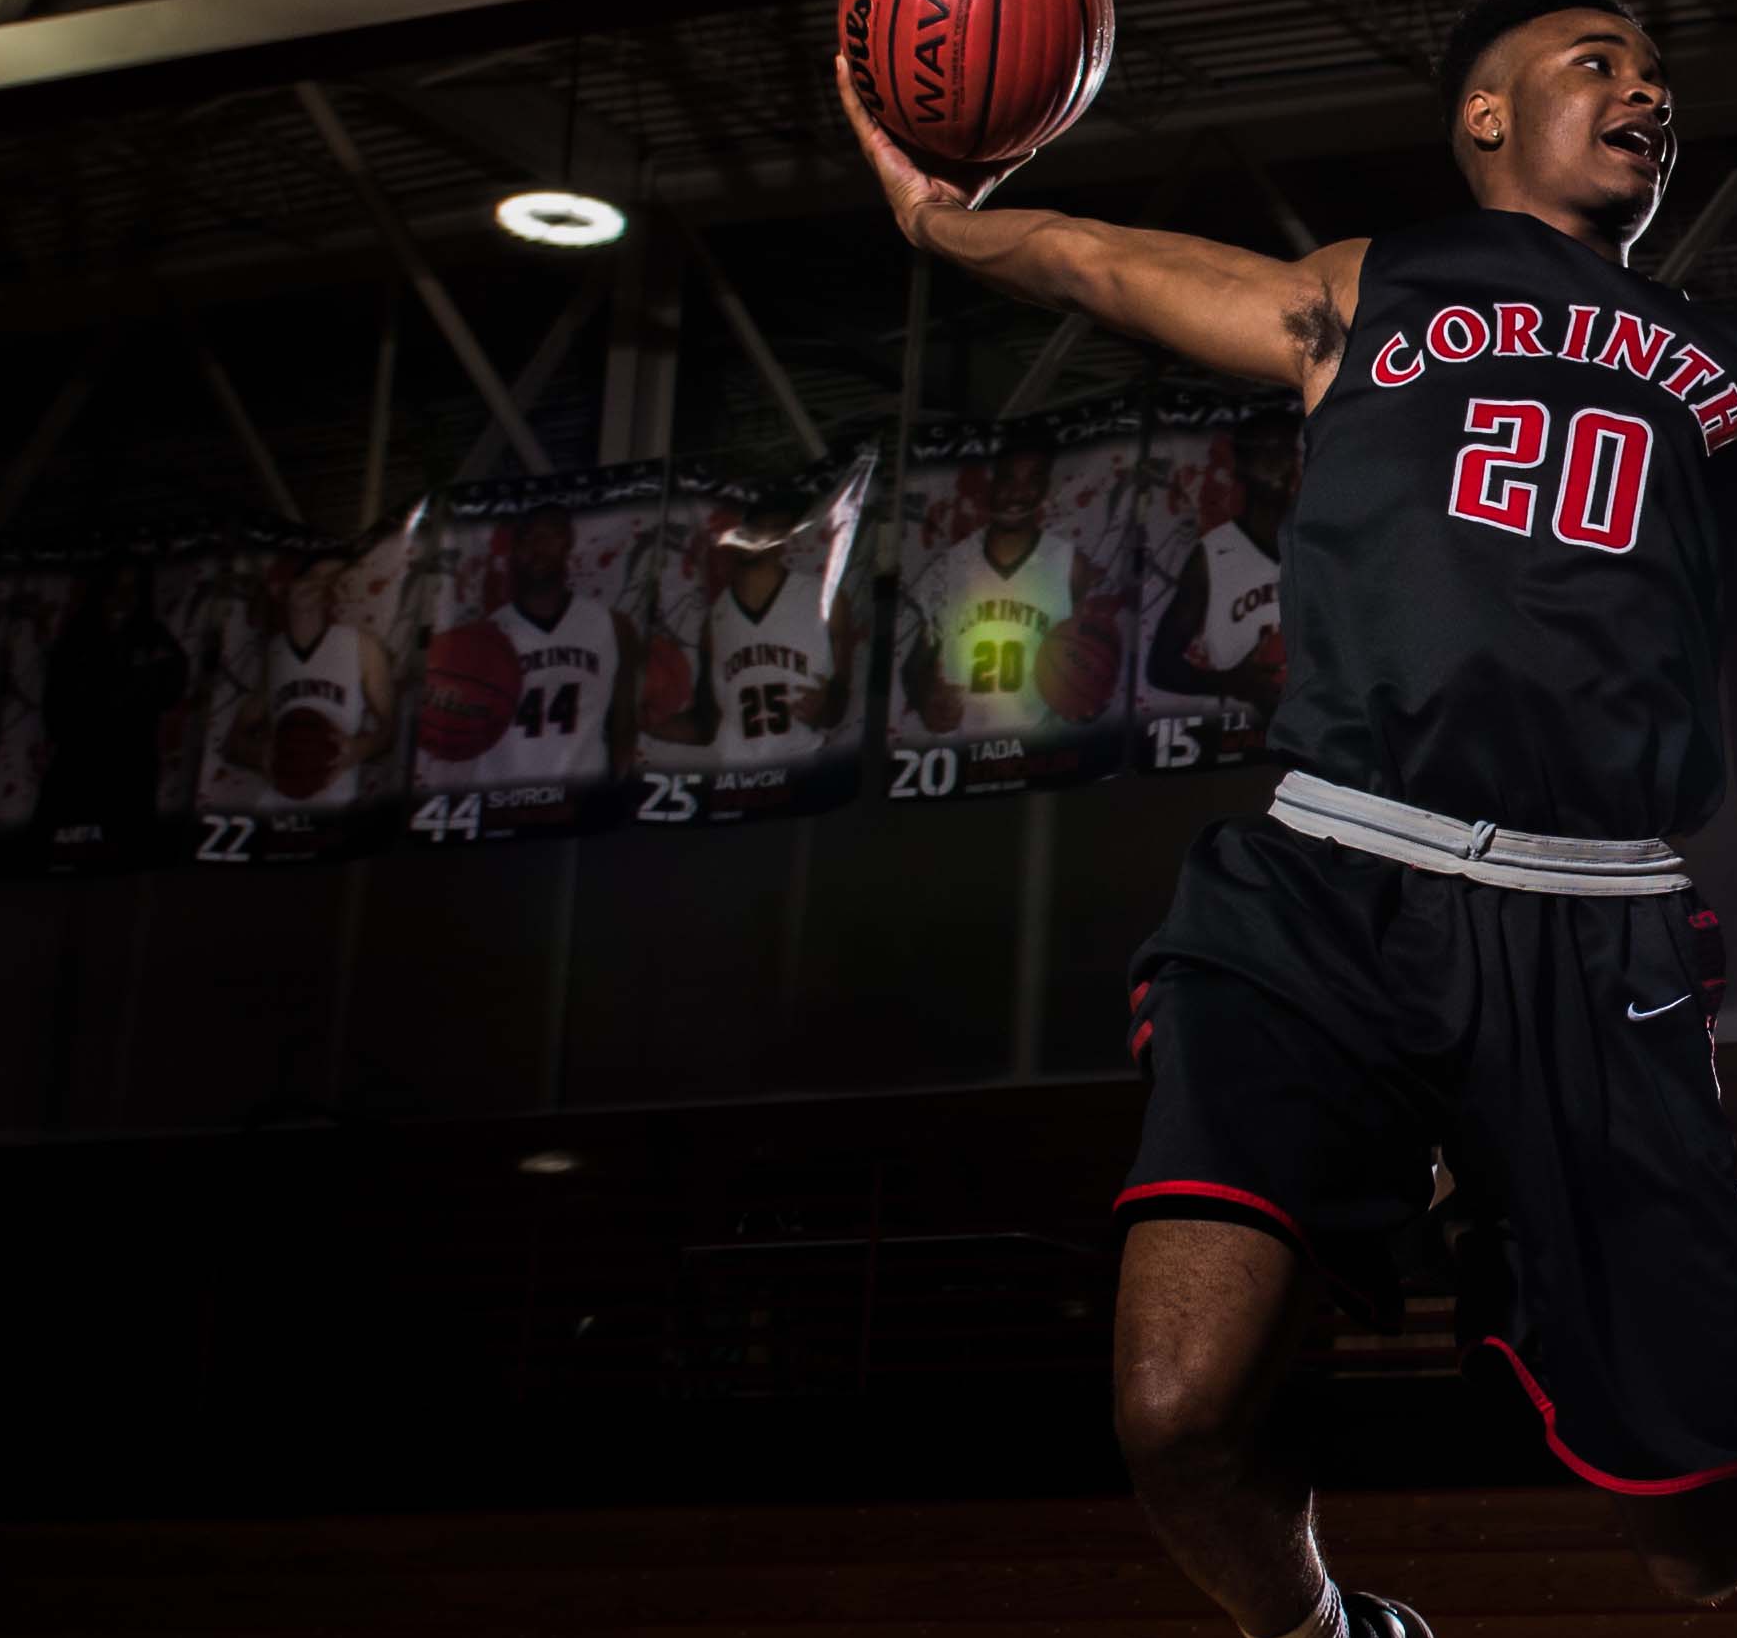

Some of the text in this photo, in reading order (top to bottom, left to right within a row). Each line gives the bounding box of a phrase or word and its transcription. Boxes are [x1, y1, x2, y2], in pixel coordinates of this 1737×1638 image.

[1448, 397, 1654, 555] 20
[969, 640, 1025, 694] 20
[516, 682, 581, 738] 44
[740, 682, 791, 740] 25
[1147, 715, 1203, 770] 15
[635, 772, 703, 823] 25
[889, 746, 958, 800] 20
[196, 815, 260, 863] 22
[409, 792, 484, 844] 44
